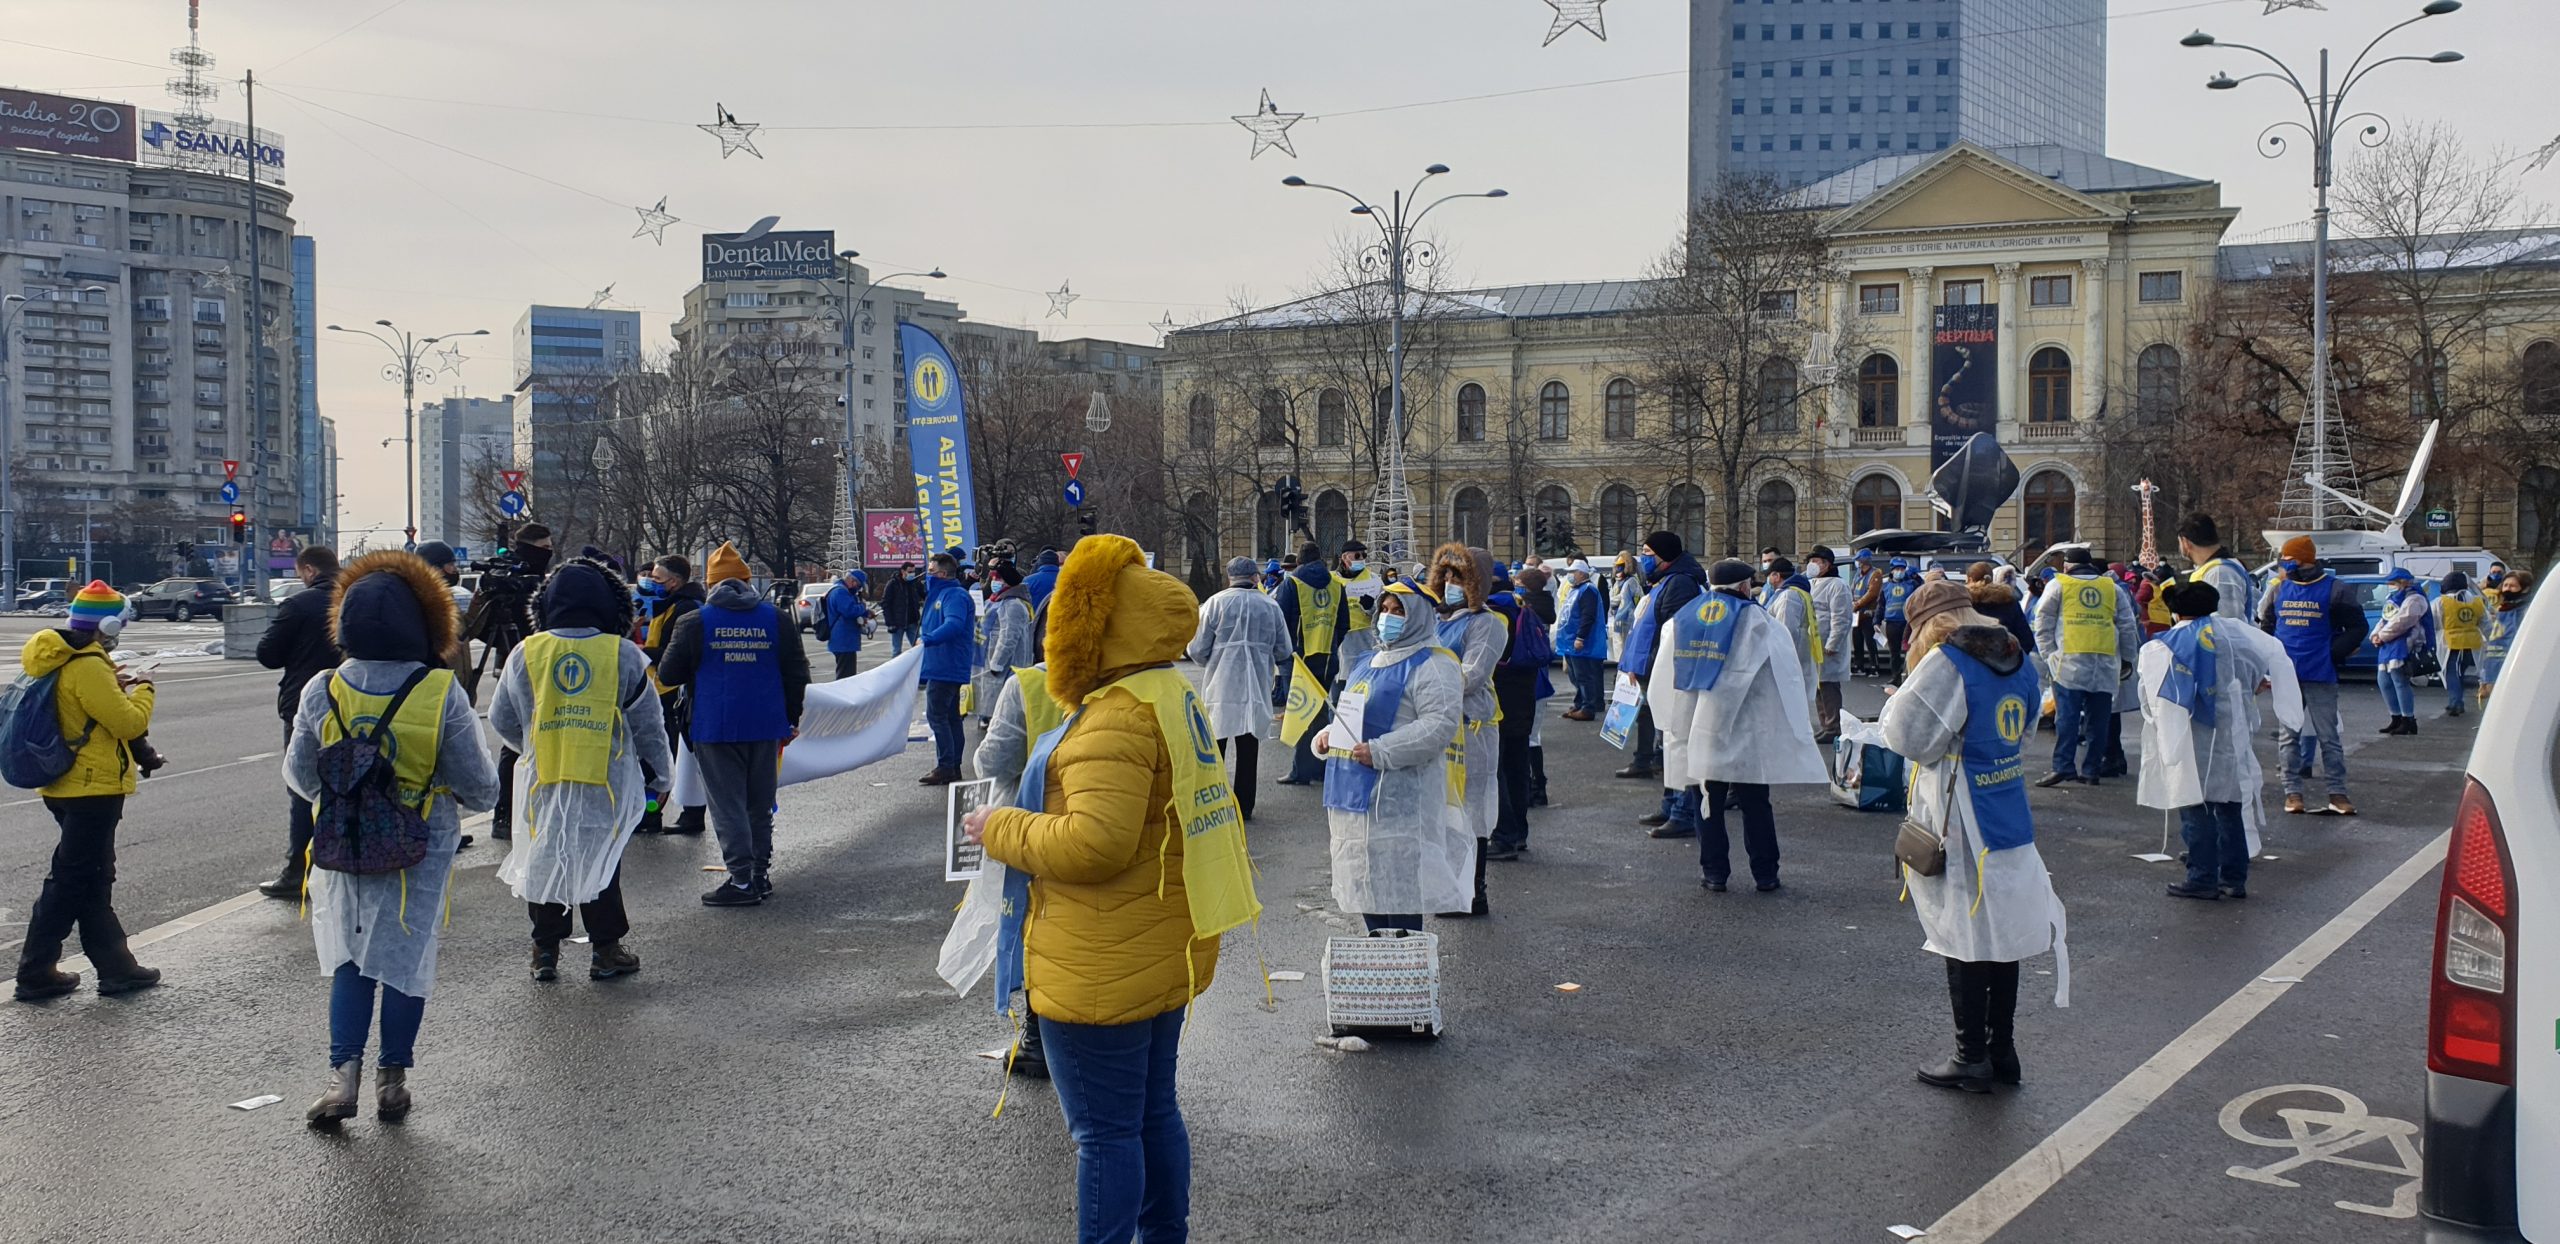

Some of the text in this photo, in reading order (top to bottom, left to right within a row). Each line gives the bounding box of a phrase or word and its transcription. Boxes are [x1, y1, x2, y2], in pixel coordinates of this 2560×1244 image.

[67, 103, 121, 132] 20
[56, 131, 100, 144] together
[175, 130, 285, 168] SANADOR
[705, 239, 831, 265] DentalMed
[1848, 245, 1887, 256] MUZEUL
[1890, 244, 1903, 253] DE
[1906, 242, 1945, 252] ISTORIE
[705, 266, 751, 279] Luxury
[796, 263, 832, 276] Clinic
